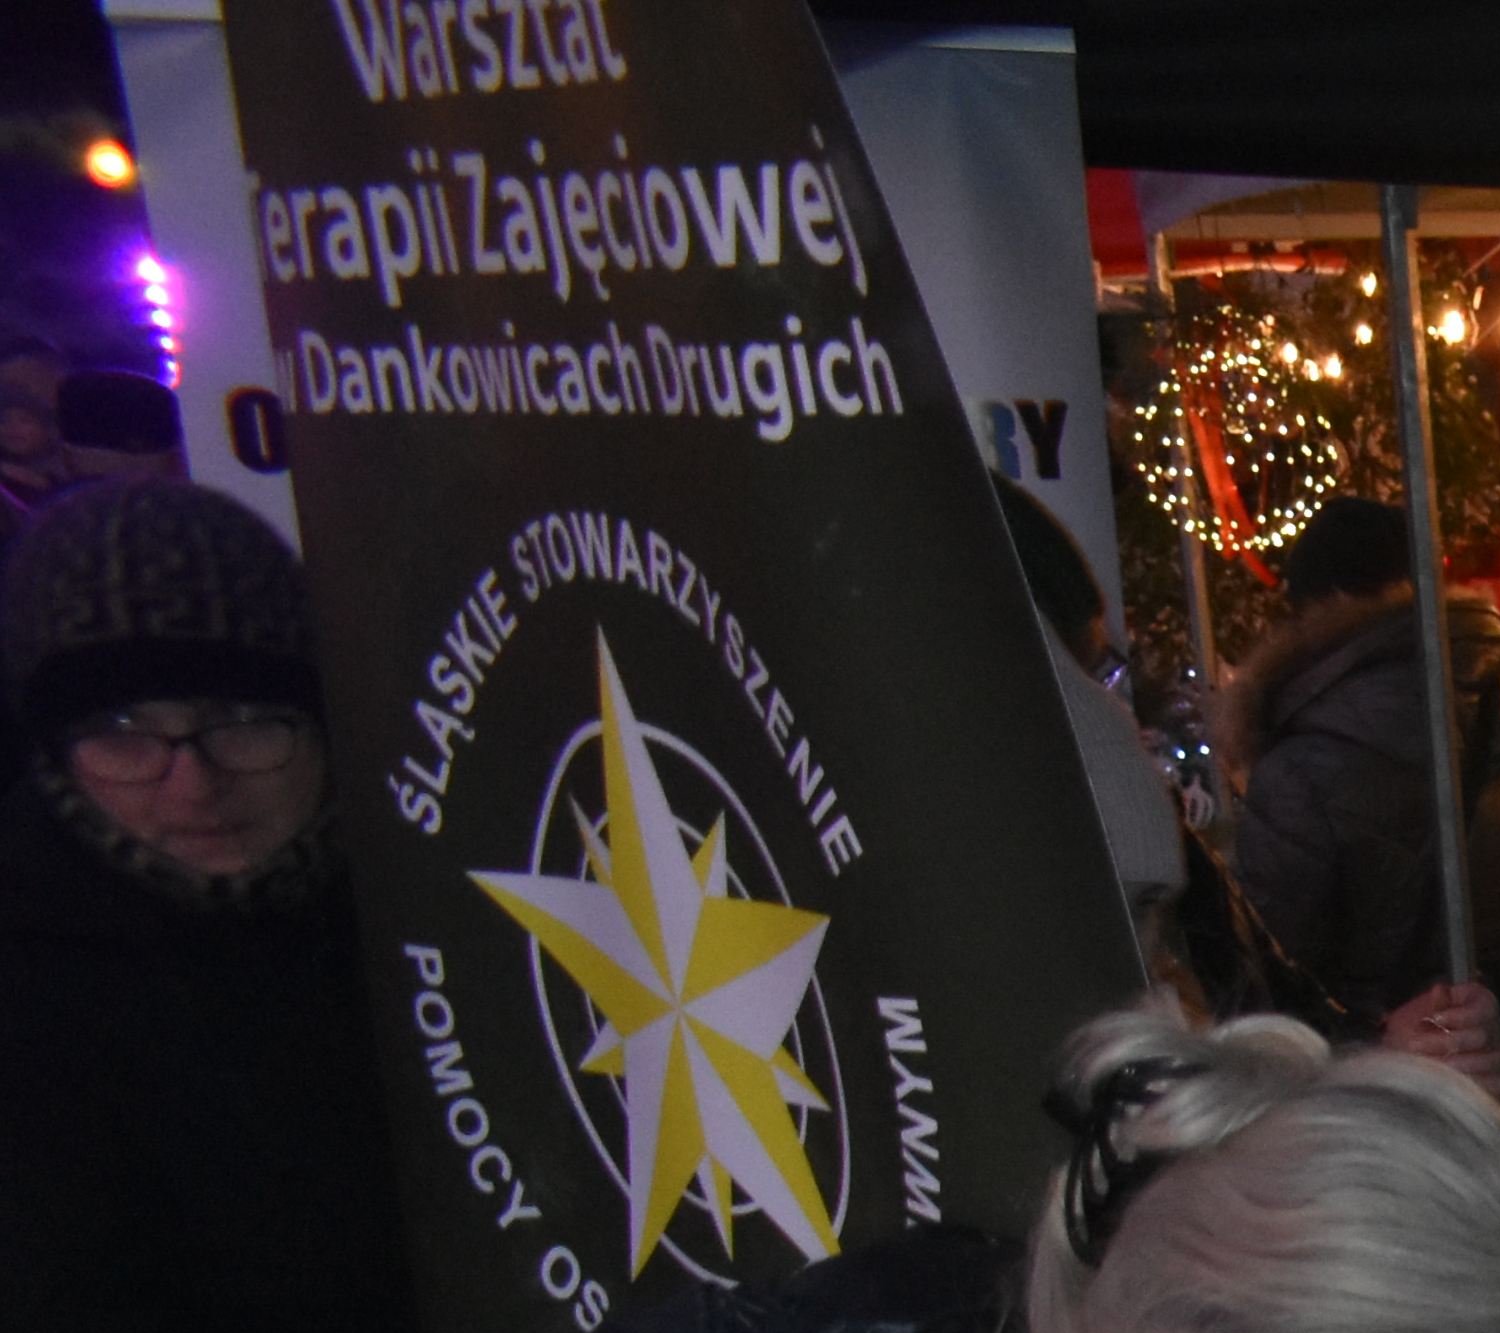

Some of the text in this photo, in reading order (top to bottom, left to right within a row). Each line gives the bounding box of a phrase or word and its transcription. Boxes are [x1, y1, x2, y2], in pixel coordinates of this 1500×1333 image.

[248, 124, 869, 309] erapii Zajęciowej
[299, 319, 650, 418] Dankowicach
[645, 315, 905, 445] Drugich
[387, 509, 865, 878] ŚLĄSKIE STOWARZYSZENIE
[403, 941, 543, 1230] POMOCY
